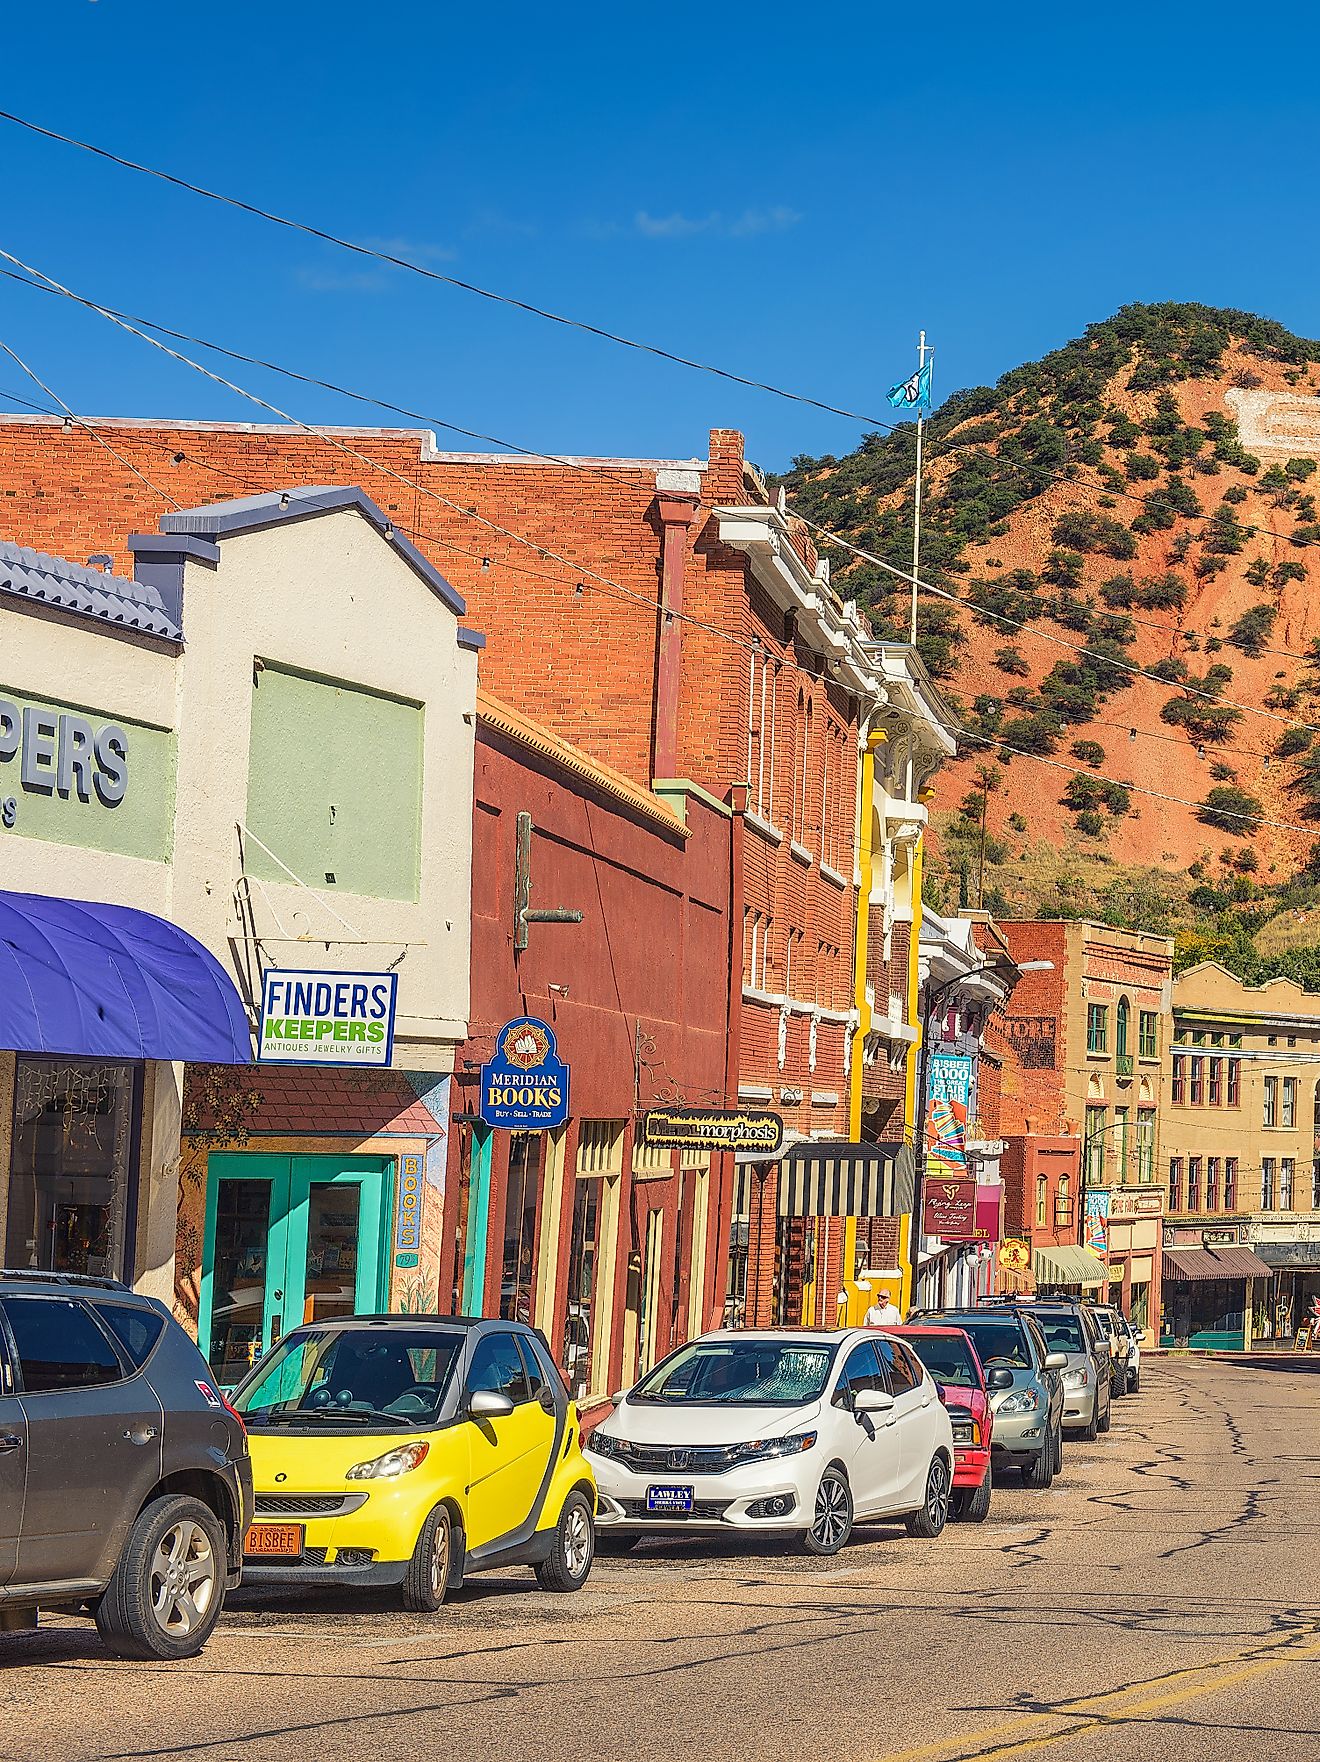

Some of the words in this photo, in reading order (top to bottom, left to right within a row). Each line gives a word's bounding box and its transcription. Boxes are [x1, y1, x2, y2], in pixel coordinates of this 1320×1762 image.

[267, 981, 388, 1019] FINDERS
[264, 1019, 385, 1043] KEEPERS
[264, 1043, 309, 1052] ANTIQUES
[313, 1044, 353, 1054] JEWELRY
[356, 1046, 381, 1055] GIFTS
[933, 1059, 970, 1069] BISBEE
[492, 1073, 557, 1086] MERIDIAN
[934, 1069, 969, 1080] 1000
[933, 1085, 966, 1094] STAIR
[487, 1087, 561, 1109] BOOKS
[933, 1093, 966, 1103] CLIMB
[401, 1158, 418, 1245] BOOKS
[650, 1490, 690, 1498] LAWLEY
[250, 1532, 294, 1547] BISBEE
